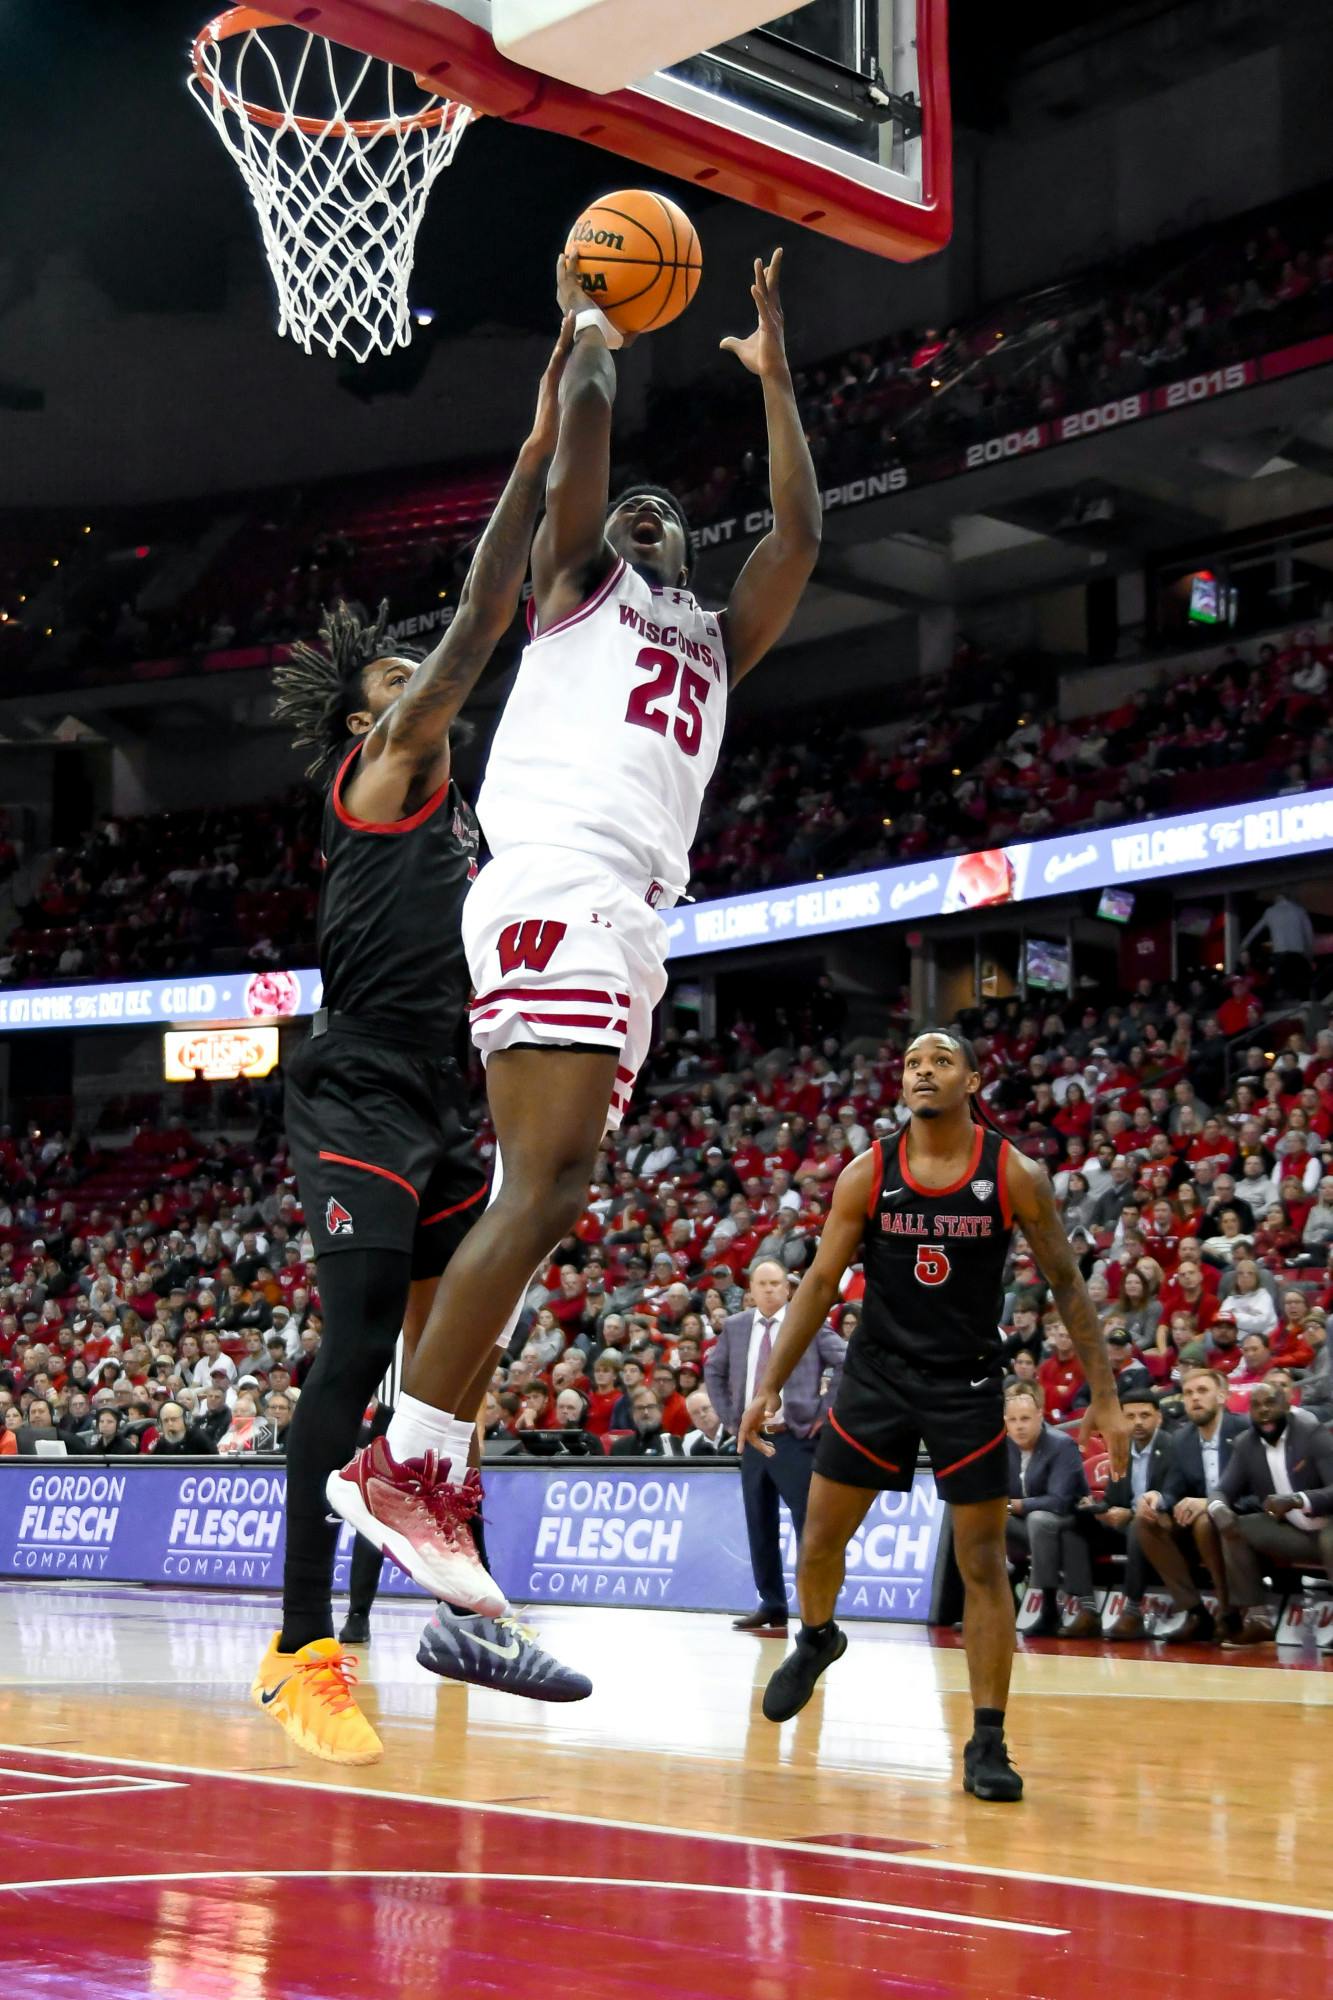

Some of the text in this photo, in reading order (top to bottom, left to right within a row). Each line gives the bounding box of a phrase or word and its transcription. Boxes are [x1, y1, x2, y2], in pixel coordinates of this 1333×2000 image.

[966, 364, 1246, 467] 2004 2008 2015
[388, 606, 454, 640] MEN'S
[619, 604, 721, 683] WISCONSN
[624, 647, 711, 757] 25
[496, 919, 568, 978] W
[880, 1212, 993, 1237] BALL STATE
[914, 1244, 951, 1286] 5
[28, 1475, 126, 1502] GORDON
[179, 1476, 287, 1506] GORDON
[546, 1480, 689, 1514] GORDON
[18, 1504, 119, 1543] FLESCH
[168, 1507, 282, 1548] FLESCH
[534, 1515, 683, 1563] FLESCH
[12, 1550, 109, 1571] COMPANY
[163, 1556, 271, 1578] COMPANY
[529, 1571, 672, 1598] COMPANY
